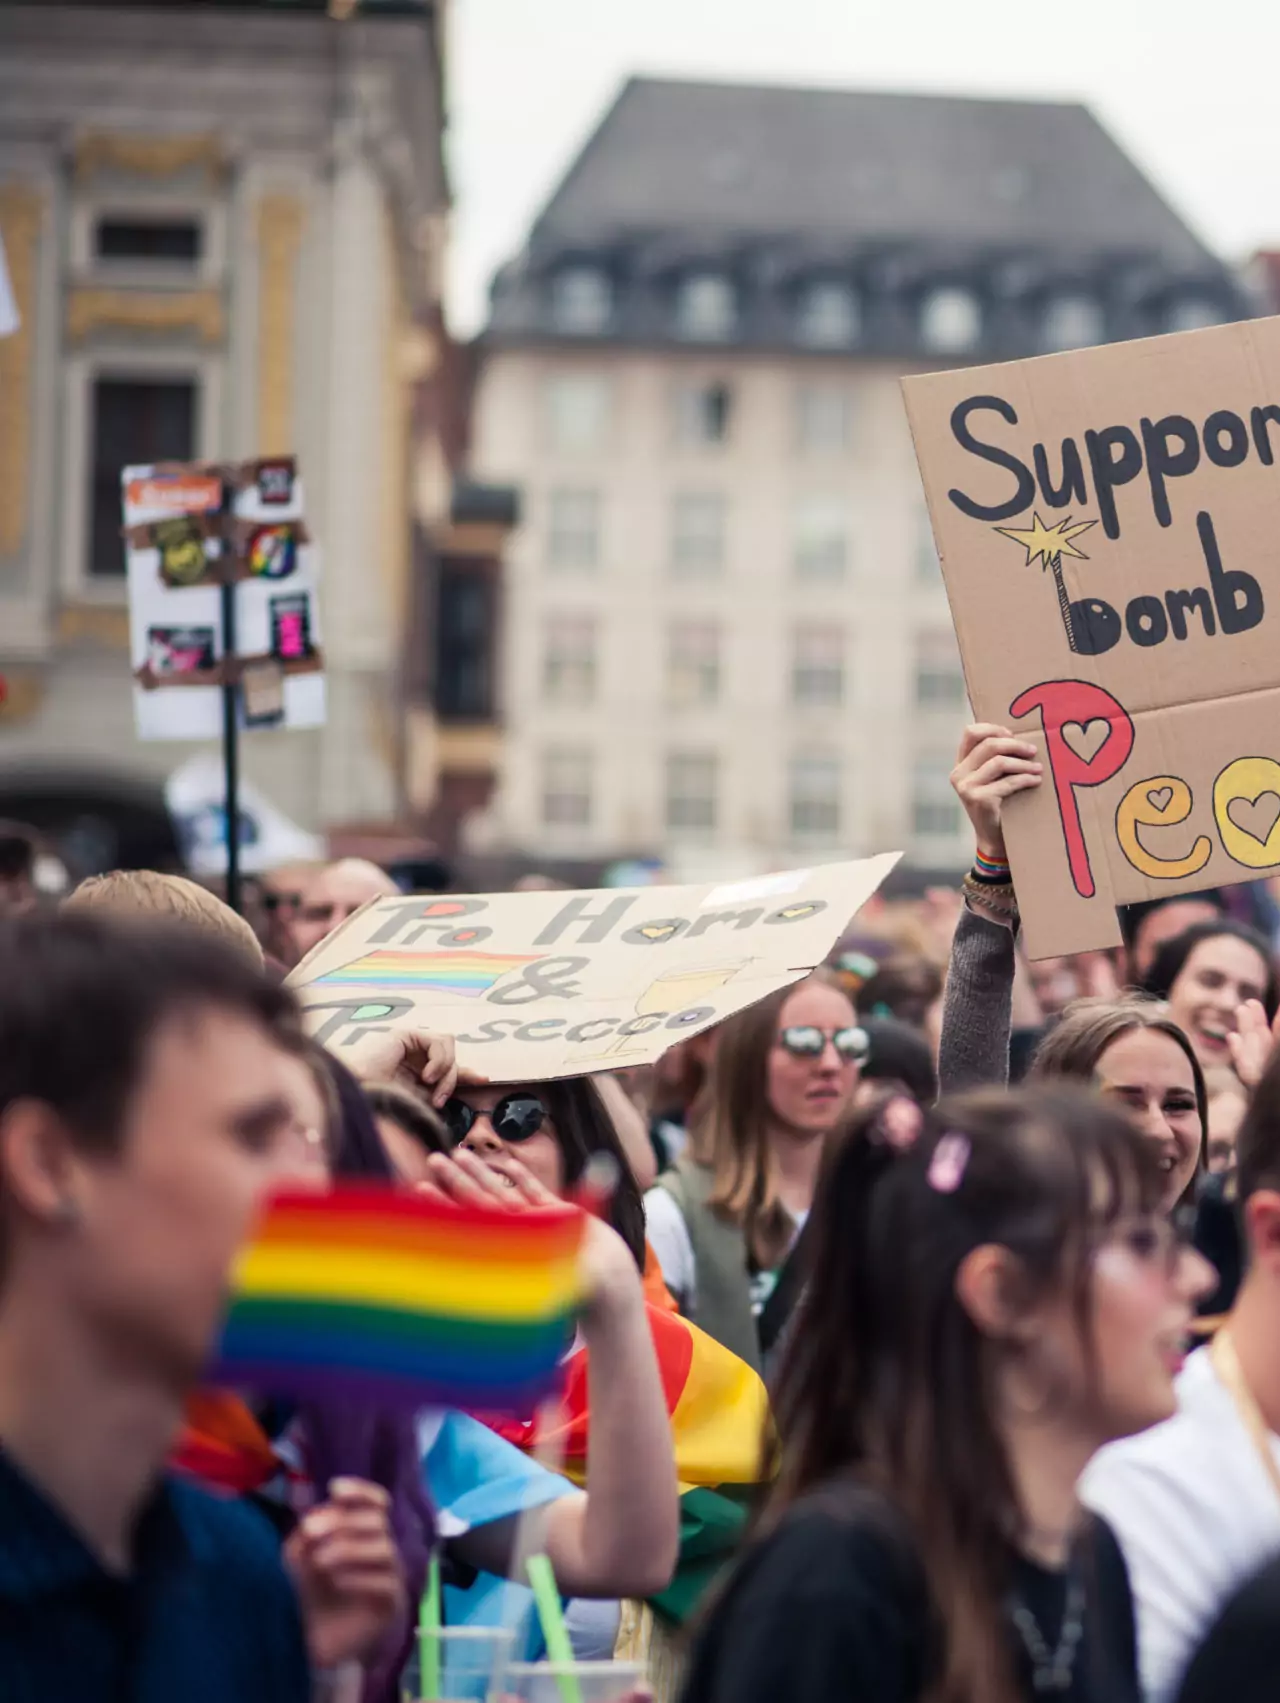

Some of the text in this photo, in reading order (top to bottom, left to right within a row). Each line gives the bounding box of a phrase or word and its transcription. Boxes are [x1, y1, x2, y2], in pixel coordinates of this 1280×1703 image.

[1052, 511, 1263, 656] bomb
[365, 895, 828, 947] Pro Homo
[486, 955, 591, 1005] &
[302, 996, 716, 1044] Prsecco
